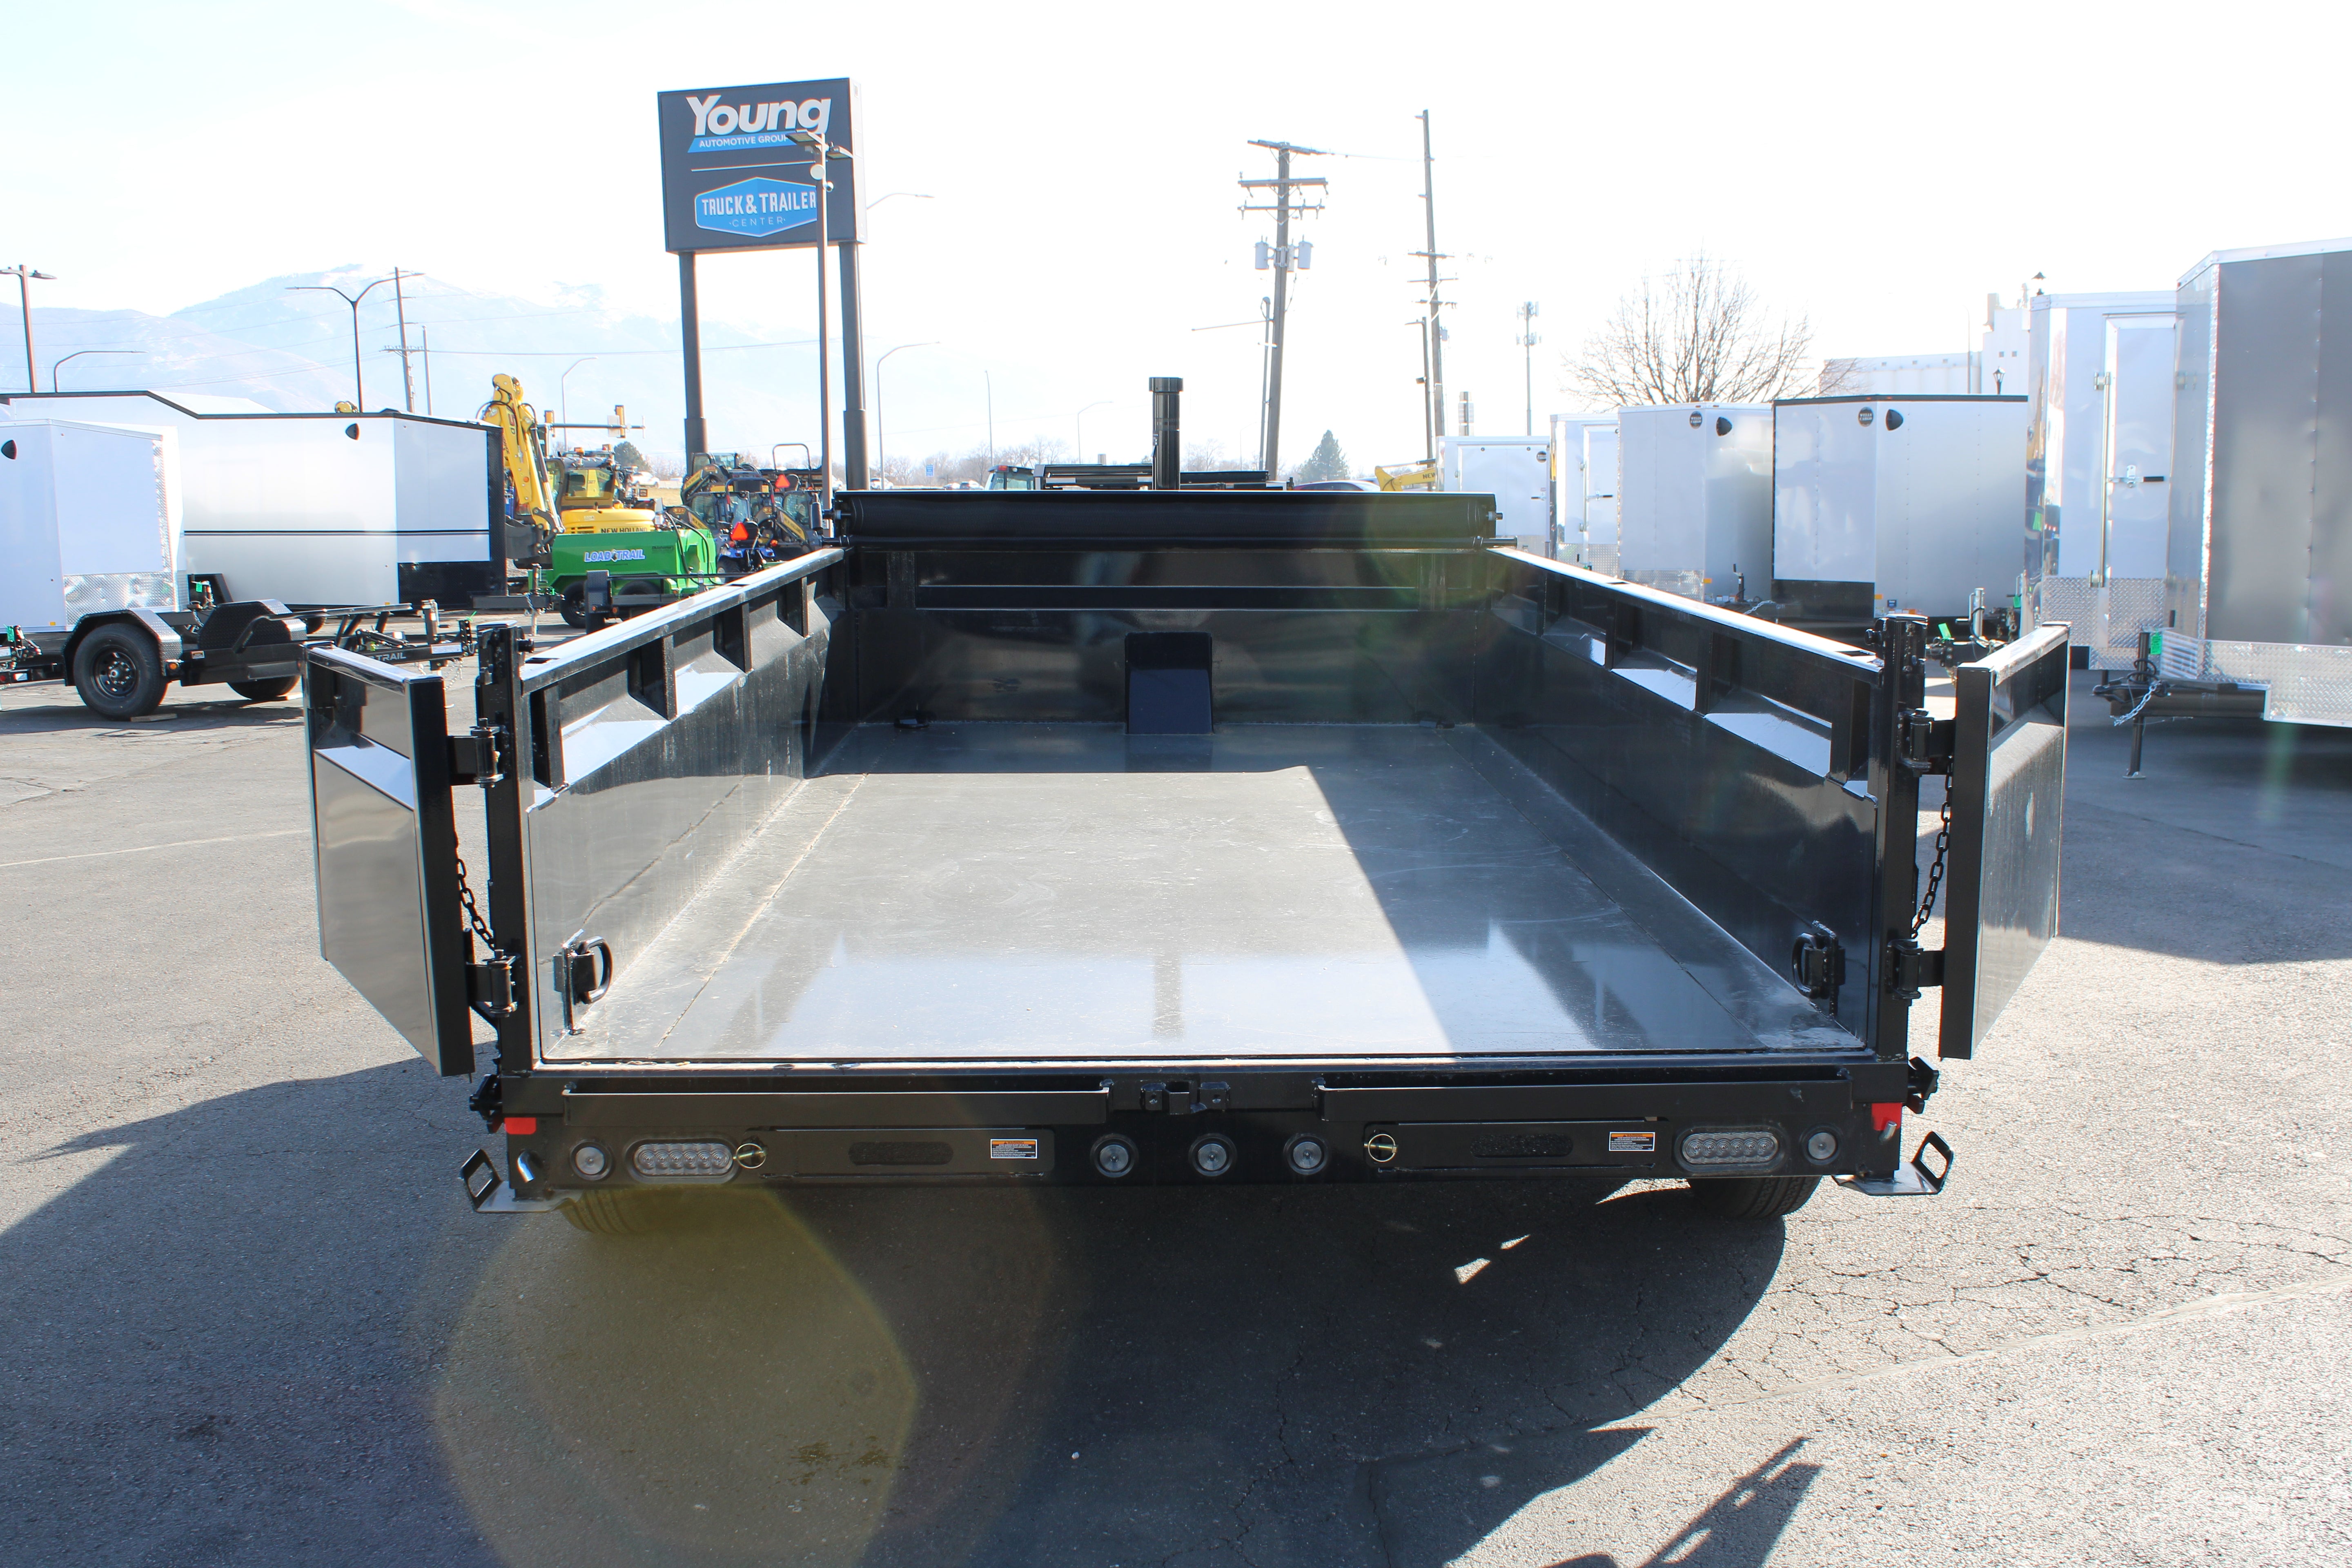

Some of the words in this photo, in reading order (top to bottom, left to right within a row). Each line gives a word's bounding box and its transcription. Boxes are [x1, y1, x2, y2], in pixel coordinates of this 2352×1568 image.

[686, 94, 832, 136] Young
[699, 136, 756, 148] AUTOMOTIVE
[702, 195, 744, 216] TRUCK
[759, 191, 816, 214] TRAILER
[732, 216, 784, 227] CENTER
[584, 551, 612, 562] LOAD
[616, 549, 645, 560] TRAIL
[376, 652, 407, 661] TRAIL
